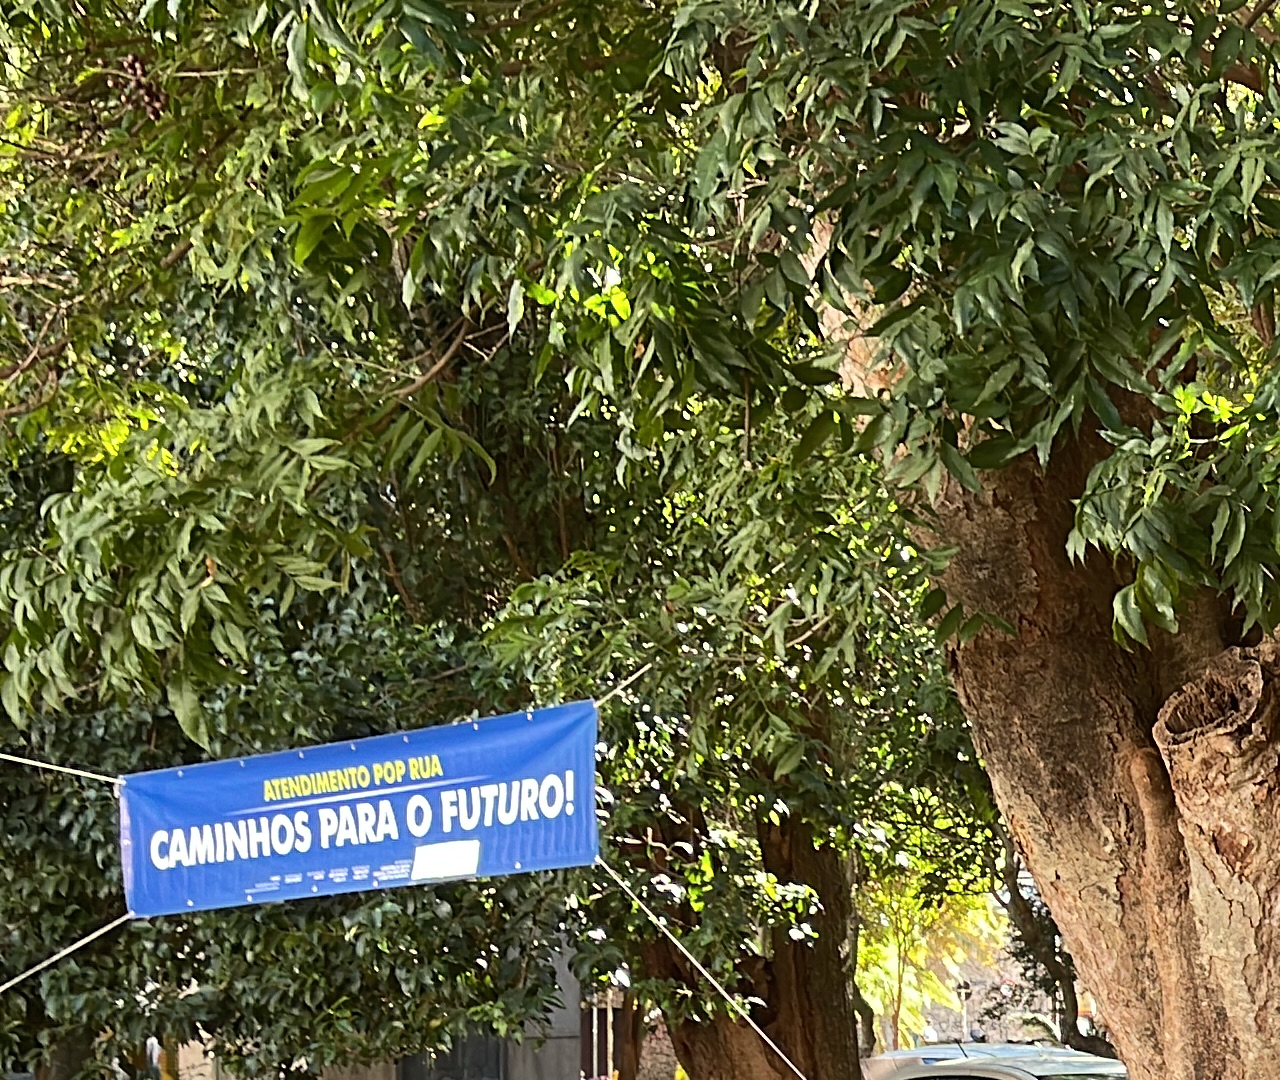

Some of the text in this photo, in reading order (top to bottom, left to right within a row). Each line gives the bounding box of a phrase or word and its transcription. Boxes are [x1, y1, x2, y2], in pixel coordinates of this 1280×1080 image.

[263, 754, 443, 802] ATENDIMENTO POP RUA
[150, 769, 575, 870] CAMINHOS PARA O FUTURO!
